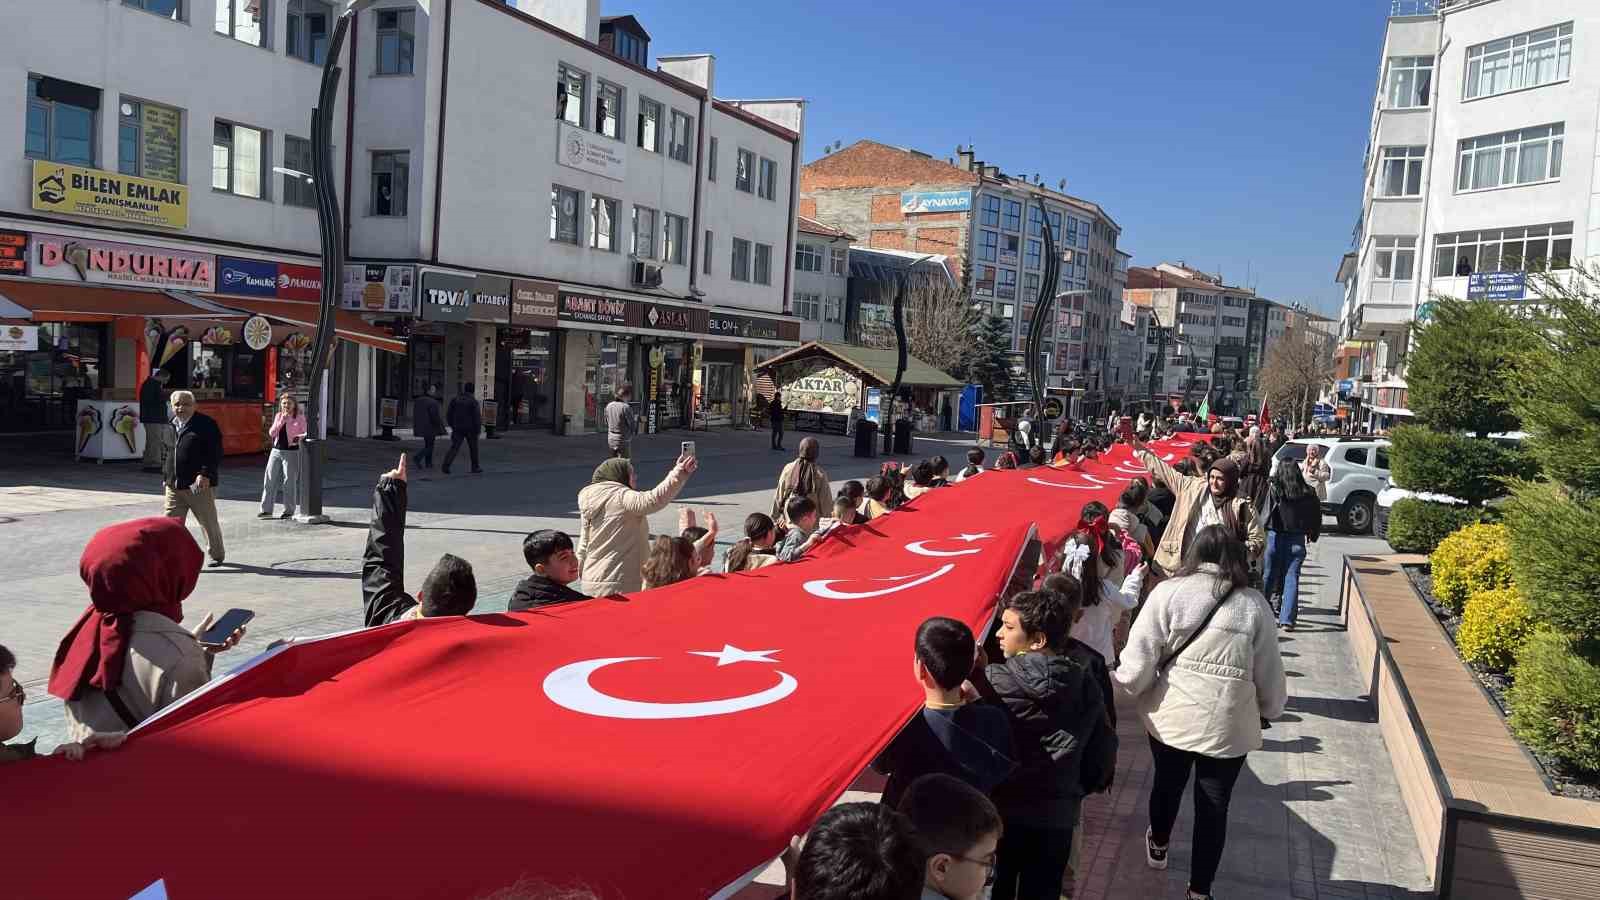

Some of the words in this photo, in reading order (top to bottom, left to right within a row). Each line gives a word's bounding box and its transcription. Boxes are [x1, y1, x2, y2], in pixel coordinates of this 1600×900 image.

[71, 171, 121, 195] BİLEN
[127, 182, 181, 205] EMLAK
[475, 291, 510, 307] KİTABEVİ
[793, 378, 842, 392] AKTAR
